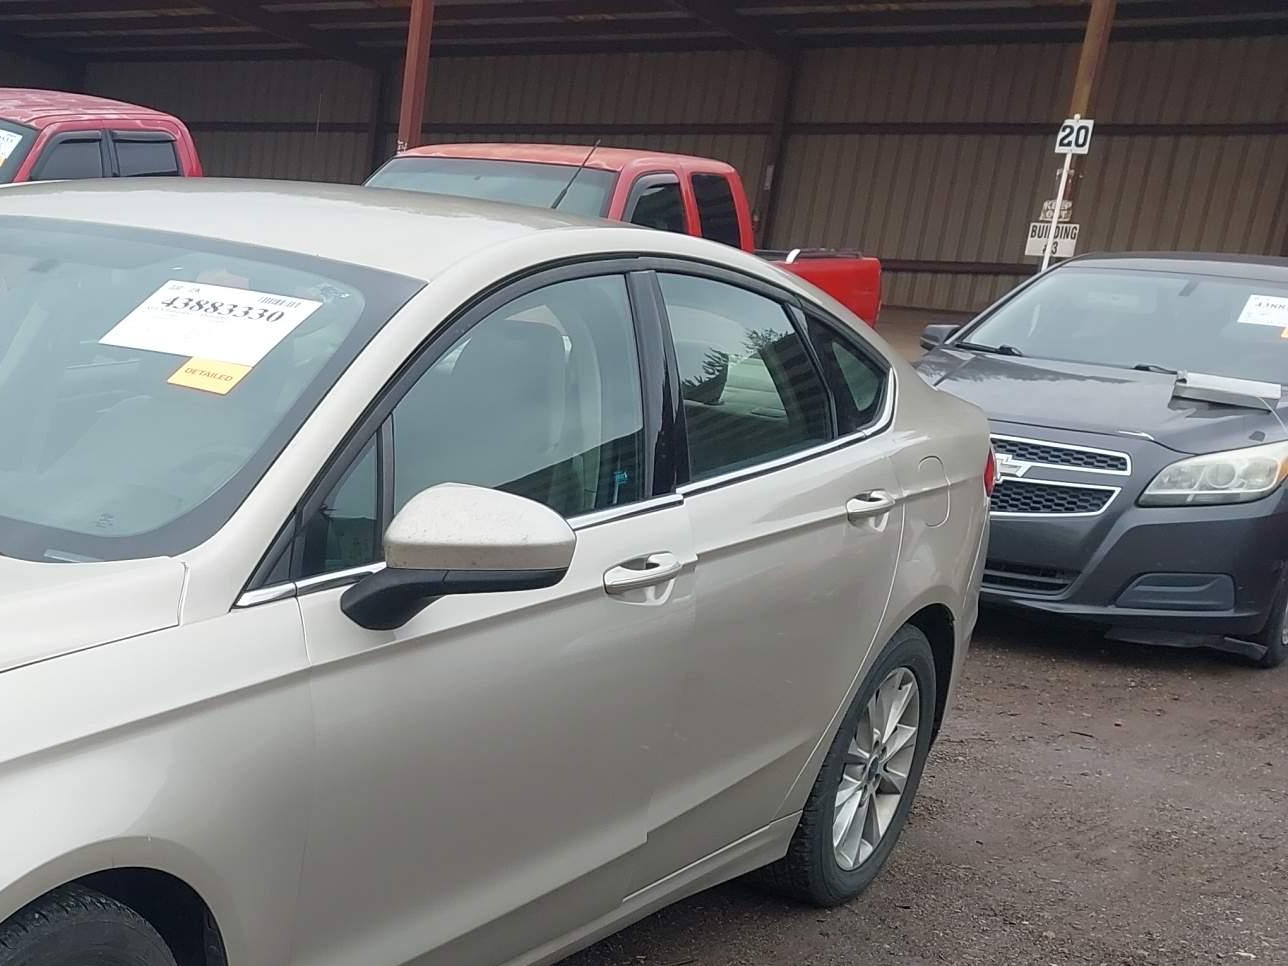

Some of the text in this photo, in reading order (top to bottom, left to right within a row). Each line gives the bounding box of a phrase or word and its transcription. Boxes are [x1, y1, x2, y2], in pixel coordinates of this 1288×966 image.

[1059, 125, 1089, 148] 20
[161, 296, 285, 323] 43883330
[184, 367, 234, 382] DETAILED
